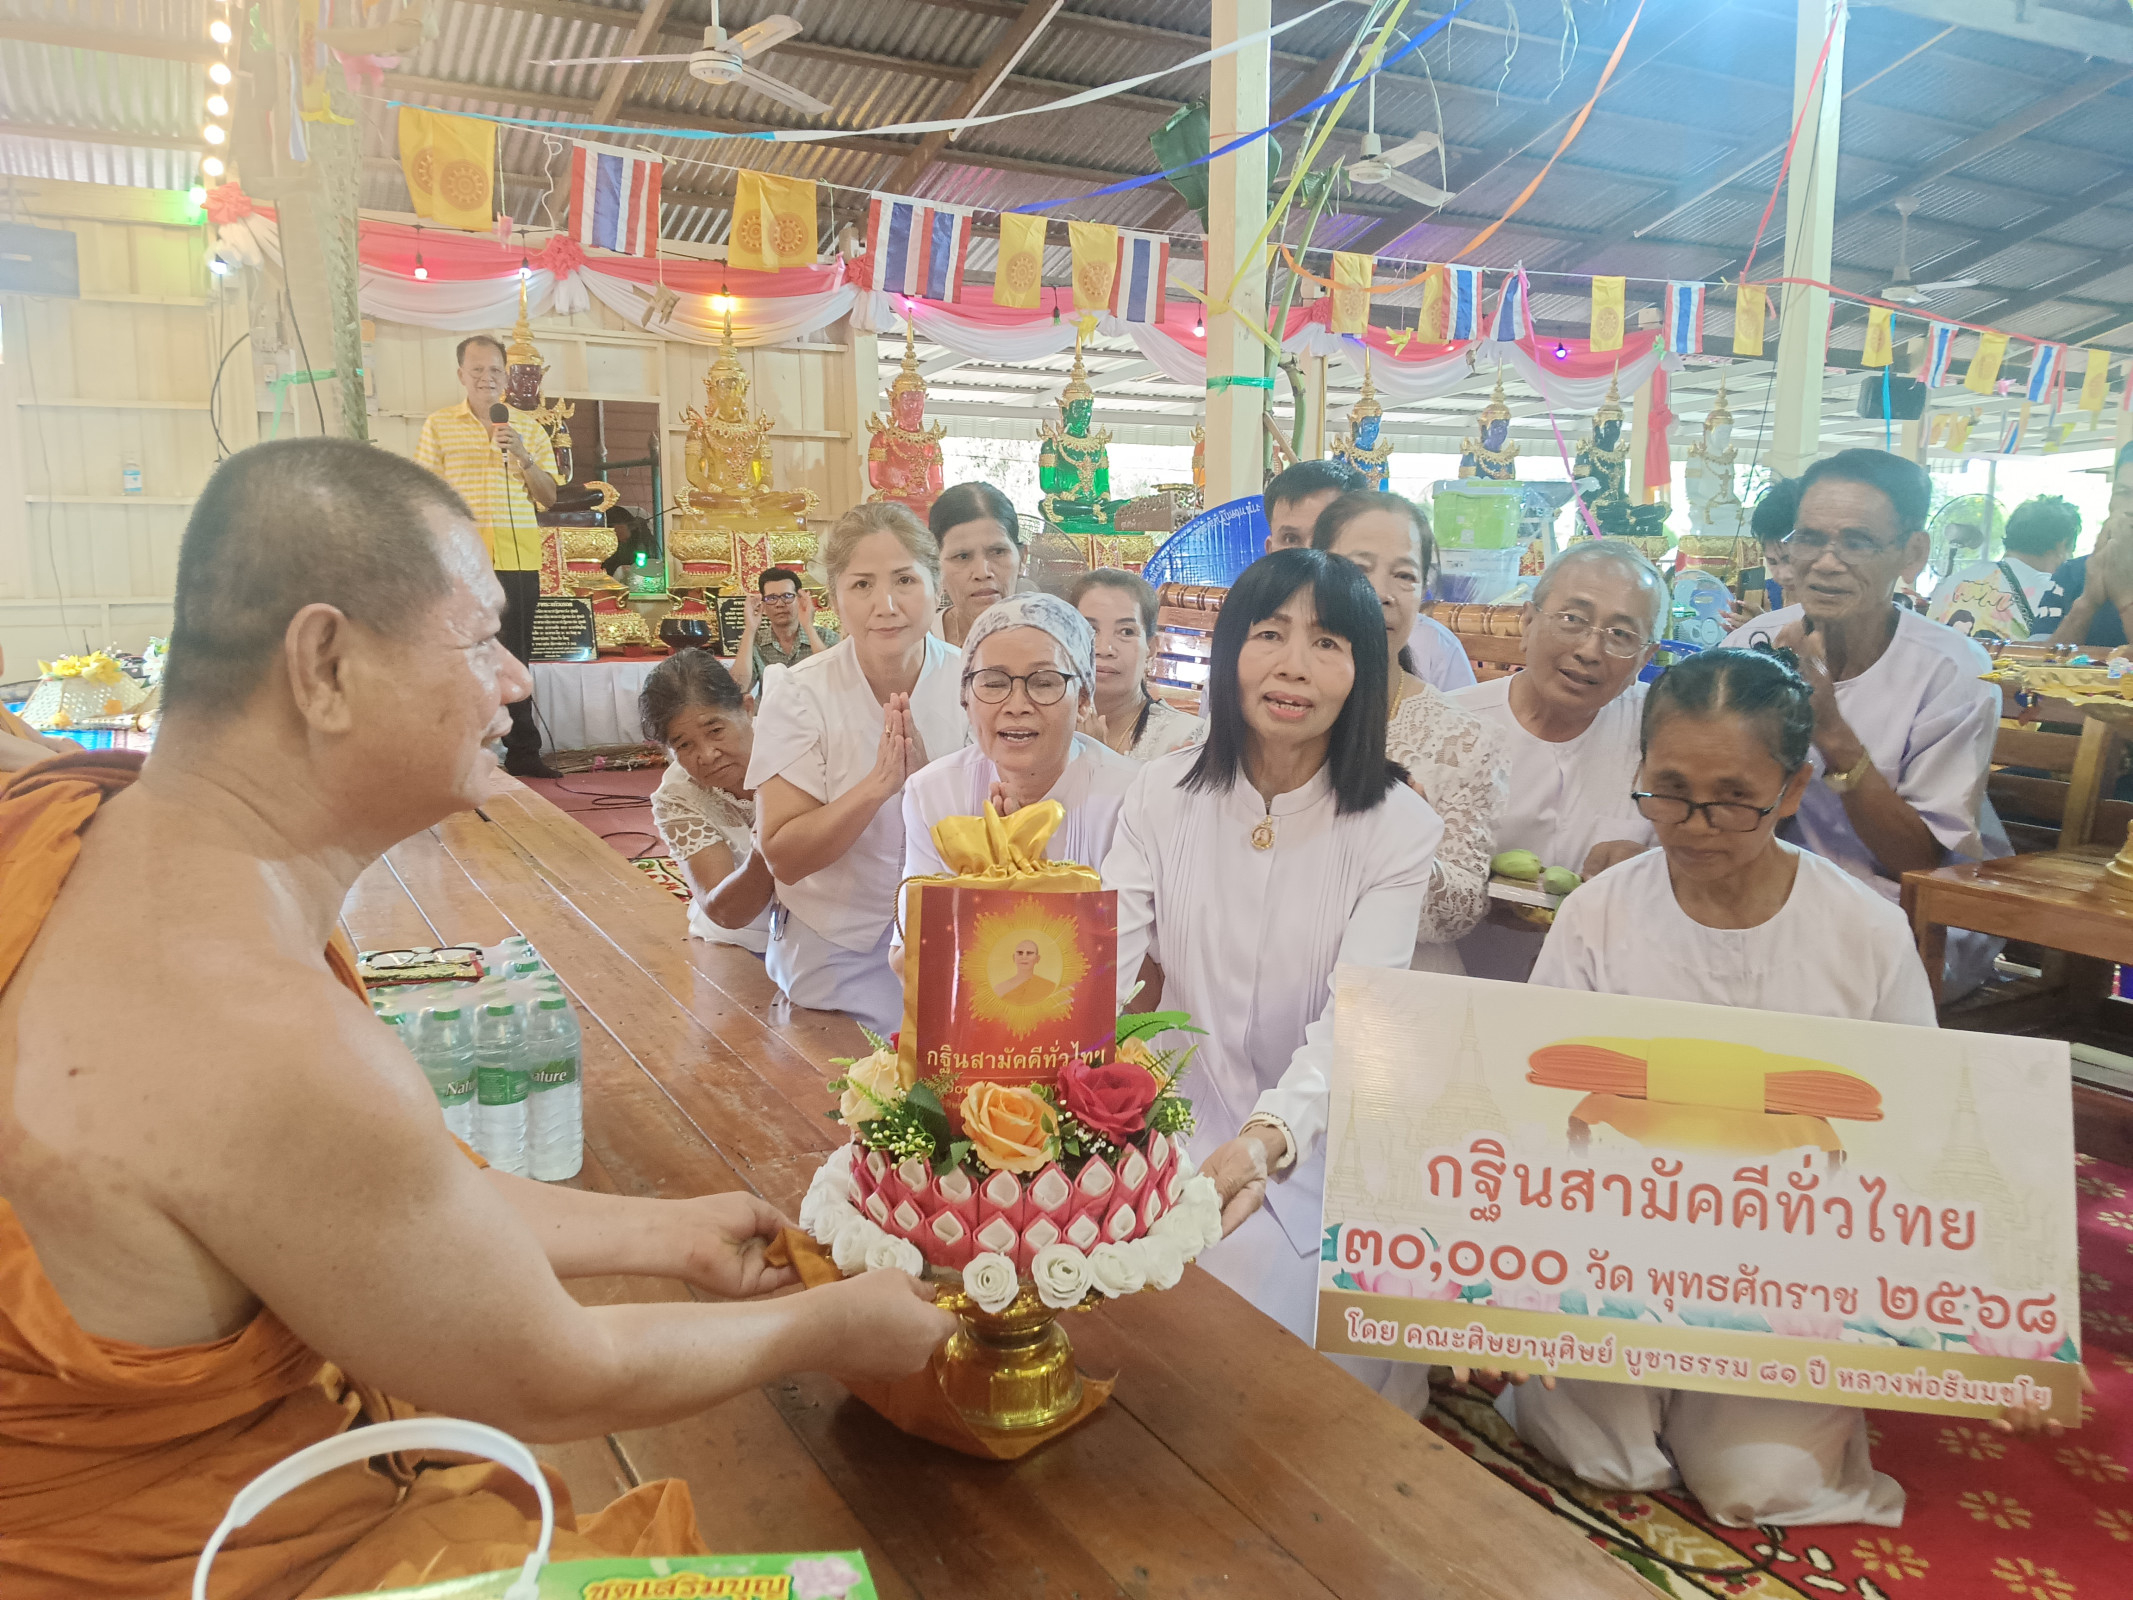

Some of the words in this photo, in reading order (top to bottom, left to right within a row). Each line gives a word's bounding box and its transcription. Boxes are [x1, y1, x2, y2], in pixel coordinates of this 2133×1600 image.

[532, 1071, 567, 1083] ature
[1427, 1137, 1976, 1251] กฐินสามัคคีทั่วไทย
[1345, 1227, 1568, 1286] ๓๐,๐๐๐
[1586, 1248, 1634, 1293] วัด
[1647, 1263, 1859, 1313] พุทธศักราช
[1877, 1275, 2057, 1335] ๒๕๖๘
[1348, 1311, 1396, 1342] โดย
[1407, 1326, 1614, 1367] คณะศิษยานุศิษย์
[1625, 1348, 1748, 1378] บูชาธรรม
[1760, 1361, 1798, 1386] ๘๑
[1808, 1358, 1827, 1386] ปี
